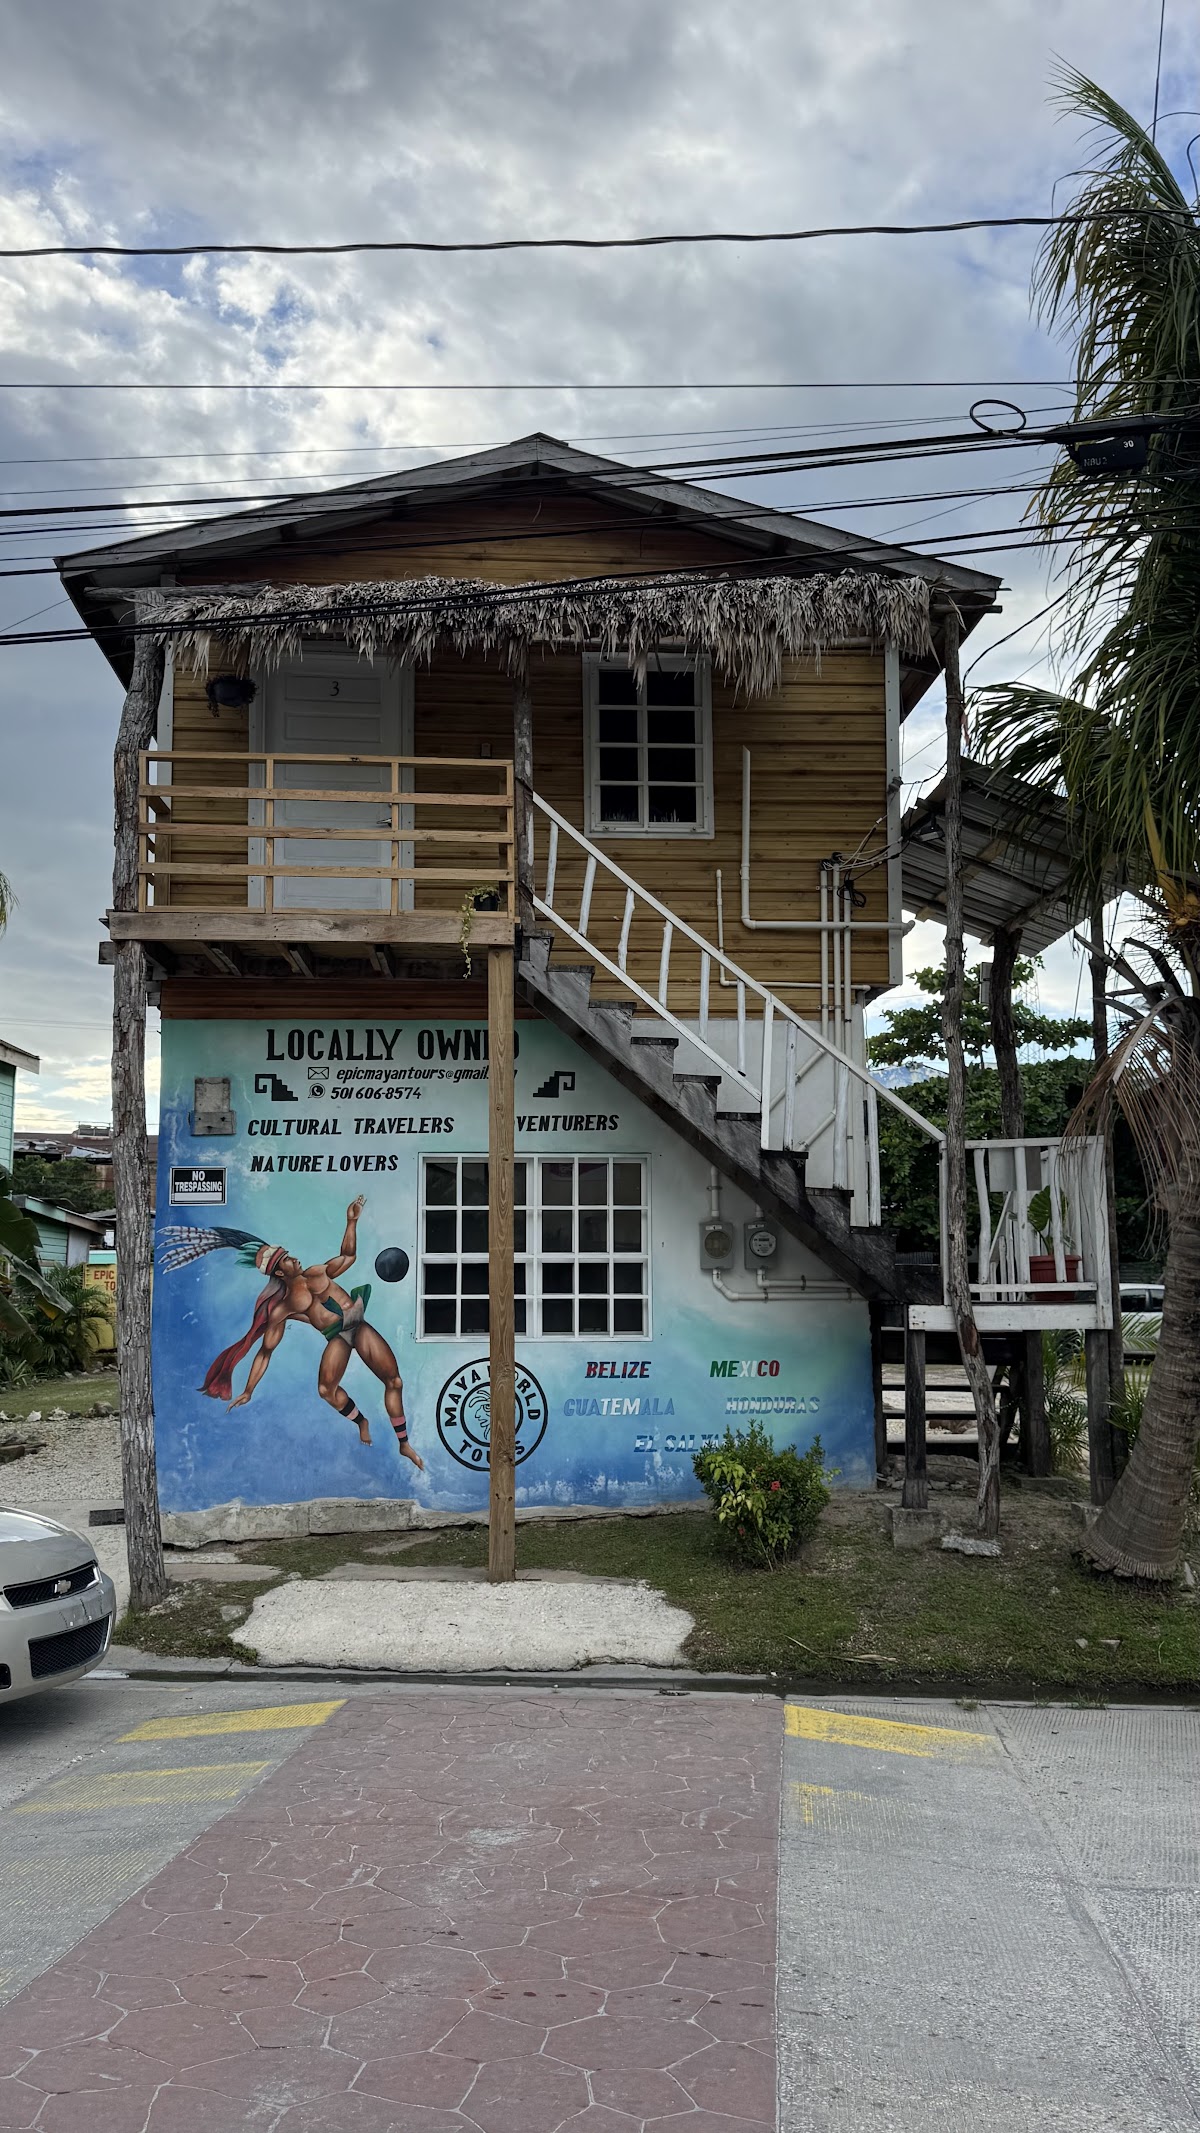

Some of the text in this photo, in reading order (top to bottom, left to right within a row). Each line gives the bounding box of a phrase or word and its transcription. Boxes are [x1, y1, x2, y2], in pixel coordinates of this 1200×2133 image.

[1123, 440, 1134, 448] 30
[330, 680, 340, 697] 3
[266, 1028, 520, 1061] LOCALLY OWN
[336, 1065, 518, 1084] epicmayantours@gmail.
[355, 1086, 422, 1100] 606-8574
[247, 1116, 455, 1136] CULTURAL TRAVELERS
[513, 1114, 620, 1132] VENTURERS
[250, 1154, 399, 1173] NATURE LOVERS
[192, 1170, 206, 1181] NO
[174, 1181, 223, 1192] TRESPASSING
[93, 1270, 115, 1280] EPIC
[584, 1361, 651, 1379] BELIZE
[709, 1360, 780, 1378] MEXICO
[444, 1369, 481, 1427] MAYA
[563, 1397, 676, 1417] GUATEMALA
[724, 1396, 820, 1415] HONDURAS
[459, 1439, 525, 1463] TOS
[633, 1434, 659, 1453] EL
